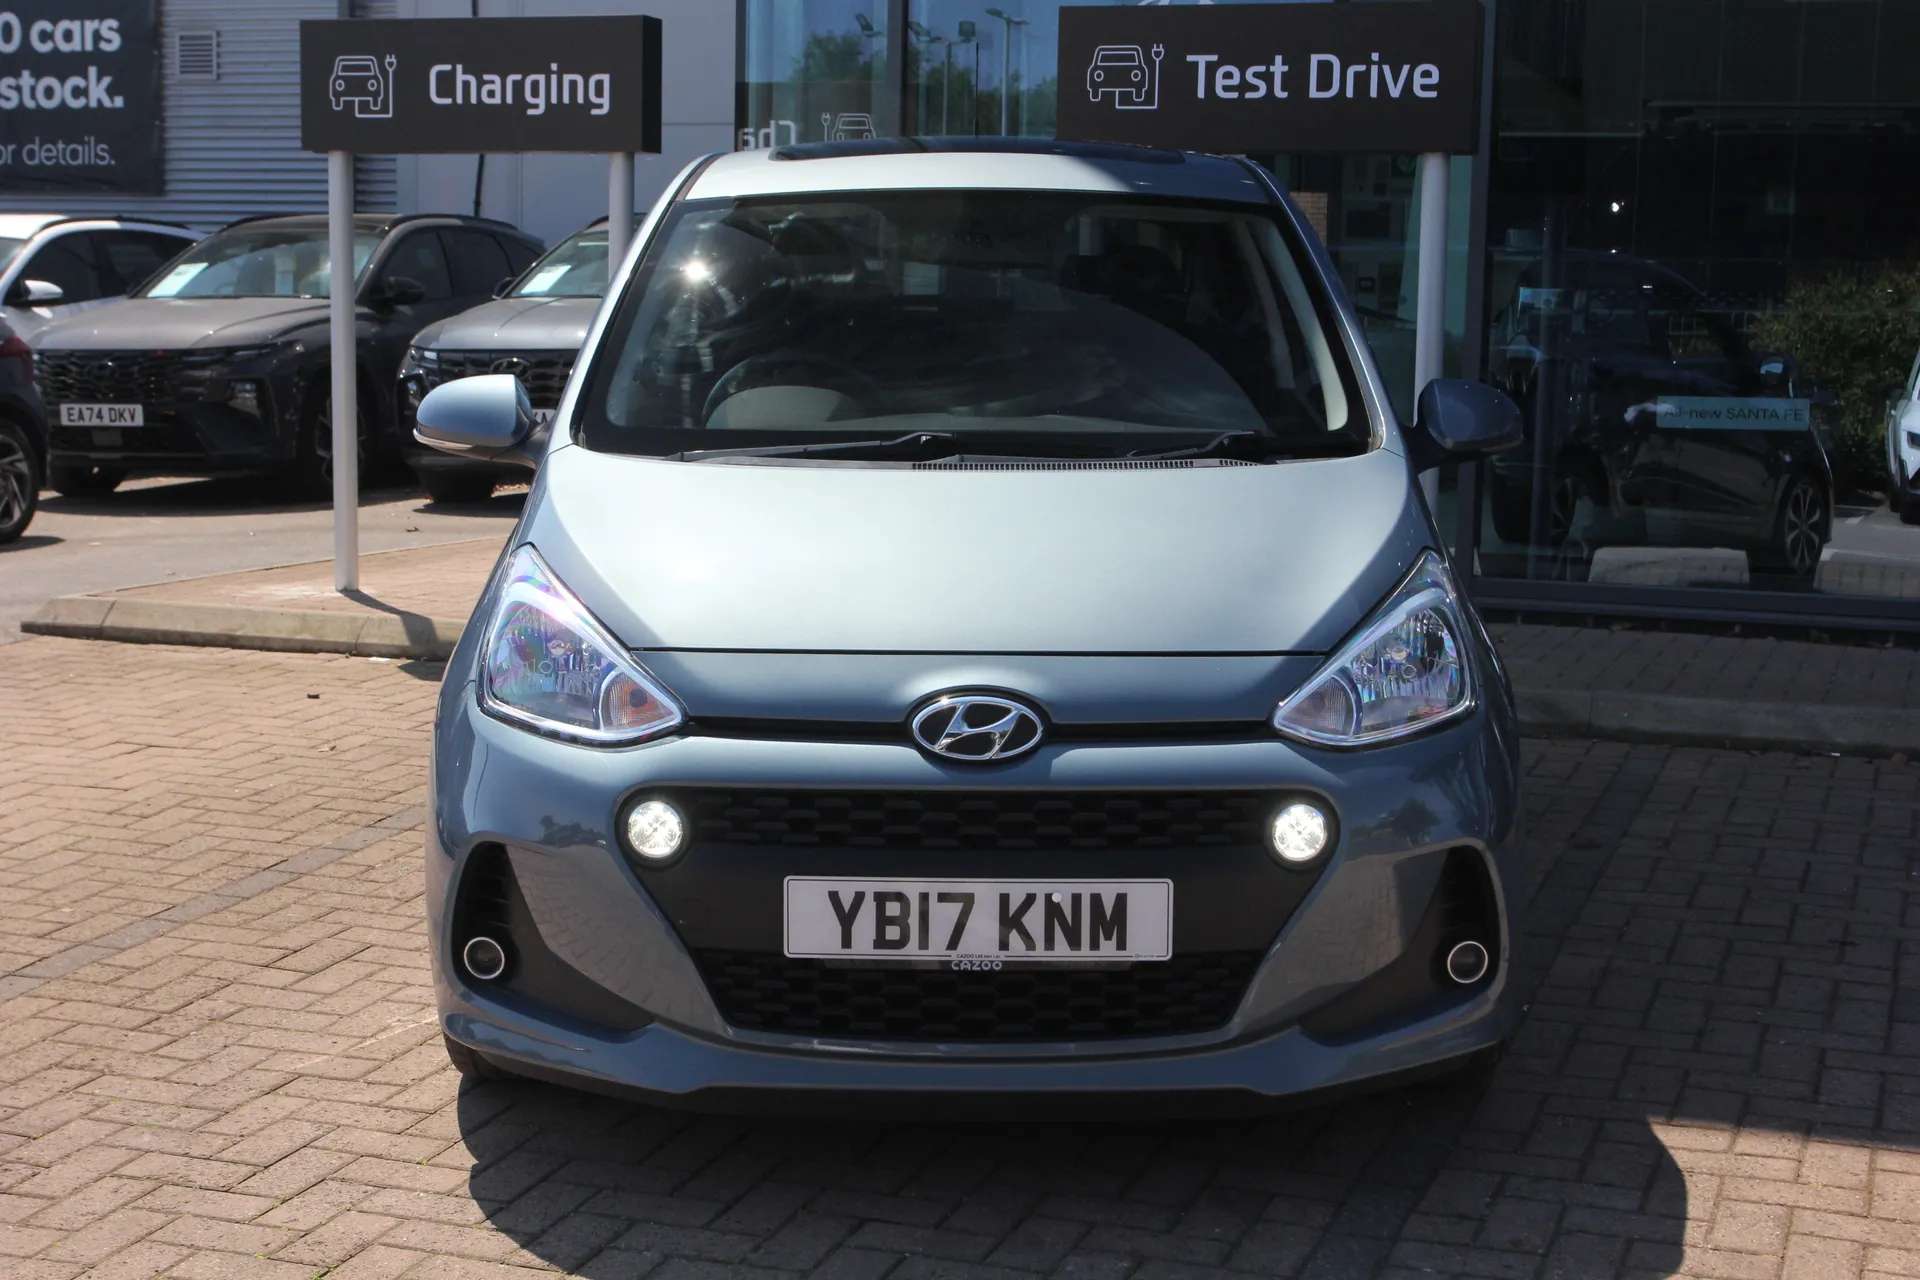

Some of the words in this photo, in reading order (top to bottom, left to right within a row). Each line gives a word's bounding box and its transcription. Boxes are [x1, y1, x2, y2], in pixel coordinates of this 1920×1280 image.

[0, 11, 22, 53] 0
[29, 18, 122, 53] cars
[0, 66, 124, 109] stock.
[429, 62, 611, 115] Charging
[1186, 54, 1289, 99] Test
[1308, 52, 1440, 99] Drive
[22, 136, 116, 165] details.
[66, 407, 104, 423] EA74
[108, 407, 136, 423] DKV
[1726, 407, 1781, 421] SANTA
[1783, 408, 1805, 421] FE
[827, 890, 976, 951] YB17
[998, 892, 1129, 952] KNM
[951, 960, 1002, 971] CAZOO
